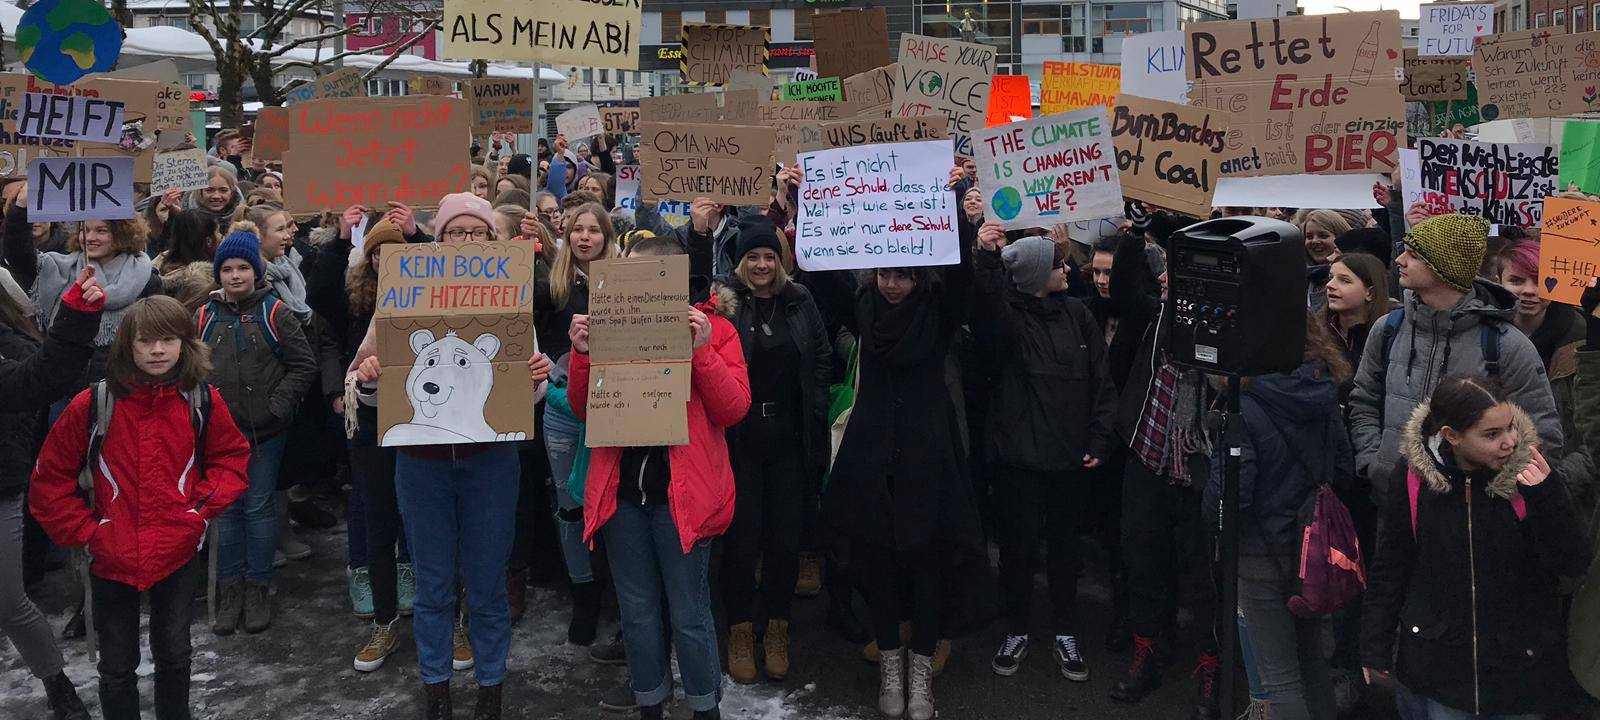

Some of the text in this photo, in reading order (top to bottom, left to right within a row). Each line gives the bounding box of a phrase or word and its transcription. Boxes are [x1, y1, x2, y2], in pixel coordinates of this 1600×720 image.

[1430, 6, 1488, 23] FRIDAYS
[451, 13, 630, 56] ALS MEIN ABI
[703, 28, 746, 42] STOP
[1442, 24, 1464, 34] FOR
[690, 44, 763, 62] CLIMATE
[905, 38, 949, 63] RAISE
[955, 46, 992, 75] YOUR
[1191, 17, 1336, 78] Rettet
[1359, 48, 1378, 59] BIER
[1480, 46, 1533, 63] Warum
[1575, 39, 1596, 53] die
[1514, 58, 1569, 75] Zukunft
[157, 86, 182, 101] ake
[474, 83, 520, 98] WARUM
[788, 84, 802, 96] ICH
[1270, 73, 1350, 111] Erde
[1399, 73, 1447, 96] Planet
[1487, 79, 1520, 91] lernen
[1529, 75, 1562, 87] wenn
[1489, 89, 1537, 104] existiert
[19, 93, 125, 137] HELFT
[300, 106, 382, 135] Wenn
[391, 100, 454, 131] nicht
[780, 105, 842, 121] CLIMATE
[898, 104, 932, 118] NOT
[938, 108, 970, 133] THE
[1111, 106, 1160, 142] Burn
[827, 121, 940, 147] UNS läuft die
[984, 129, 1026, 157] THE
[1032, 117, 1102, 147] CLIMATE
[1265, 111, 1295, 142] ist
[1311, 111, 1342, 135] der
[1345, 116, 1405, 135] einzige
[336, 136, 420, 169] Jetzt
[704, 135, 740, 155] WAS
[1220, 131, 1399, 175] anet mit BIER
[166, 157, 198, 168] Sterne
[660, 157, 709, 172] IST EIN
[803, 149, 899, 183] Es ist nicht
[994, 142, 1103, 180] IS CHANGING
[1155, 150, 1209, 192] Coal
[37, 162, 122, 212] MIR
[650, 167, 763, 196] SCHNEEMANN?
[803, 174, 951, 201] deine Schuld, dass die
[1023, 164, 1112, 195] WHY AREN'T
[1421, 160, 1534, 200] ARTENSCHUTZ
[1533, 179, 1557, 199] ist
[307, 177, 388, 207] Wann
[1423, 192, 1450, 208] und
[802, 203, 830, 218] Welt
[863, 202, 888, 212] wie
[895, 198, 915, 211] sie
[1459, 200, 1482, 216] der
[802, 222, 823, 238] Es
[861, 224, 886, 235] nur
[1556, 209, 1592, 231] ZUKUNFT
[801, 247, 834, 261] wenn
[837, 243, 859, 255] sie
[864, 243, 883, 255] so
[400, 255, 511, 280] KEIN BOCK
[382, 285, 527, 309] AUF HITZEFREI!
[614, 292, 625, 303] ich
[591, 317, 606, 326] zum
[631, 315, 653, 327] laufen
[614, 306, 625, 315] ich
[628, 305, 641, 314] ihn
[639, 343, 668, 353] nur noch
